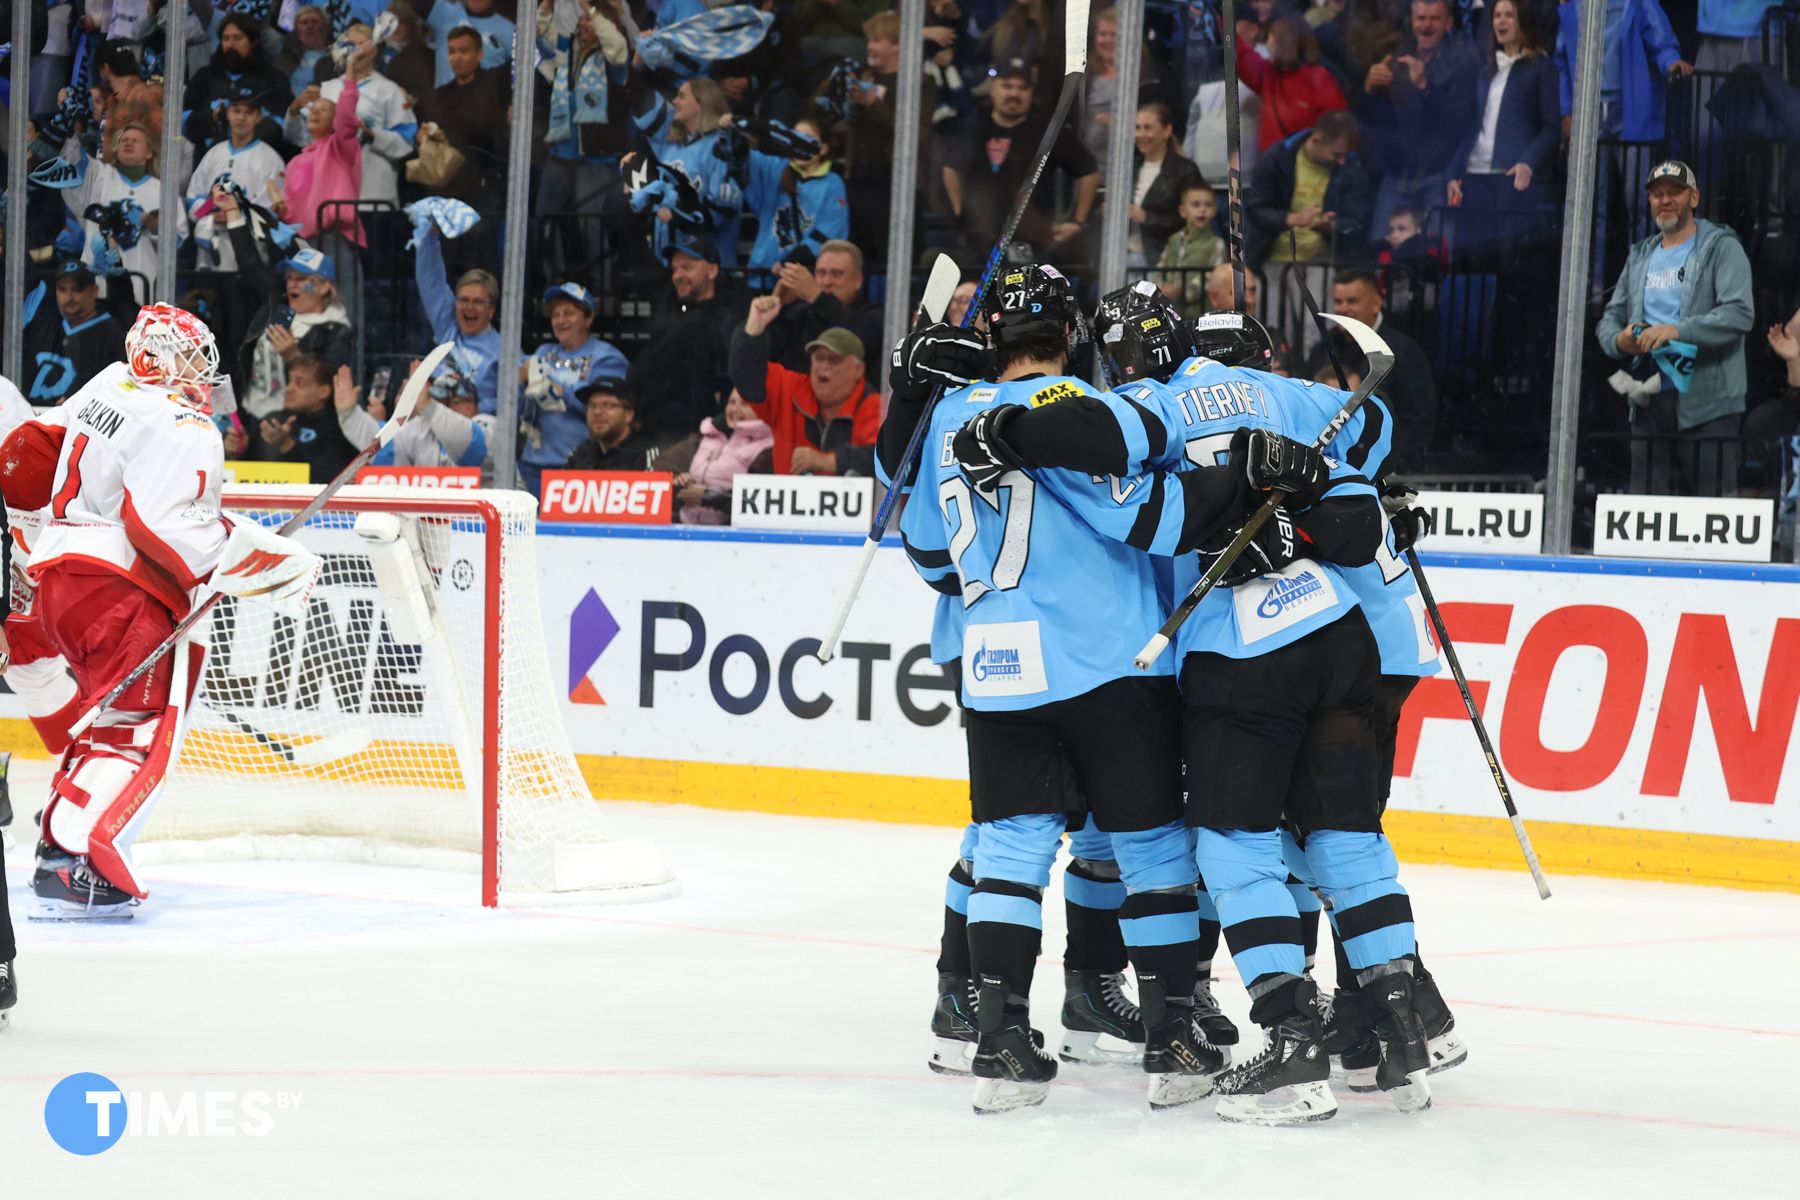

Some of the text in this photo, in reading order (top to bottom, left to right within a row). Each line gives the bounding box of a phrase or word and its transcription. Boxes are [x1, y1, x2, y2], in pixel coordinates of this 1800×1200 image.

[1004, 290, 1025, 310] 27
[1200, 317, 1242, 328] Belavia
[1152, 345, 1172, 366] 71
[1209, 346, 1233, 356] CCM
[1034, 384, 1071, 405] MAX
[1175, 380, 1270, 427] TIERNEY
[77, 398, 125, 439] GALKIN
[53, 431, 90, 519] 1
[194, 468, 207, 501] 1
[542, 479, 669, 516] FONBET
[740, 488, 863, 518] KHL.RU
[938, 468, 1037, 610] 27
[1430, 507, 1532, 539] L.RU
[1605, 510, 1761, 544] KHL.RU
[640, 600, 966, 729] Росте
[1486, 750, 1510, 801] TRUE
[1001, 1048, 1025, 1075] CCM
[1171, 1040, 1206, 1073] CCM
